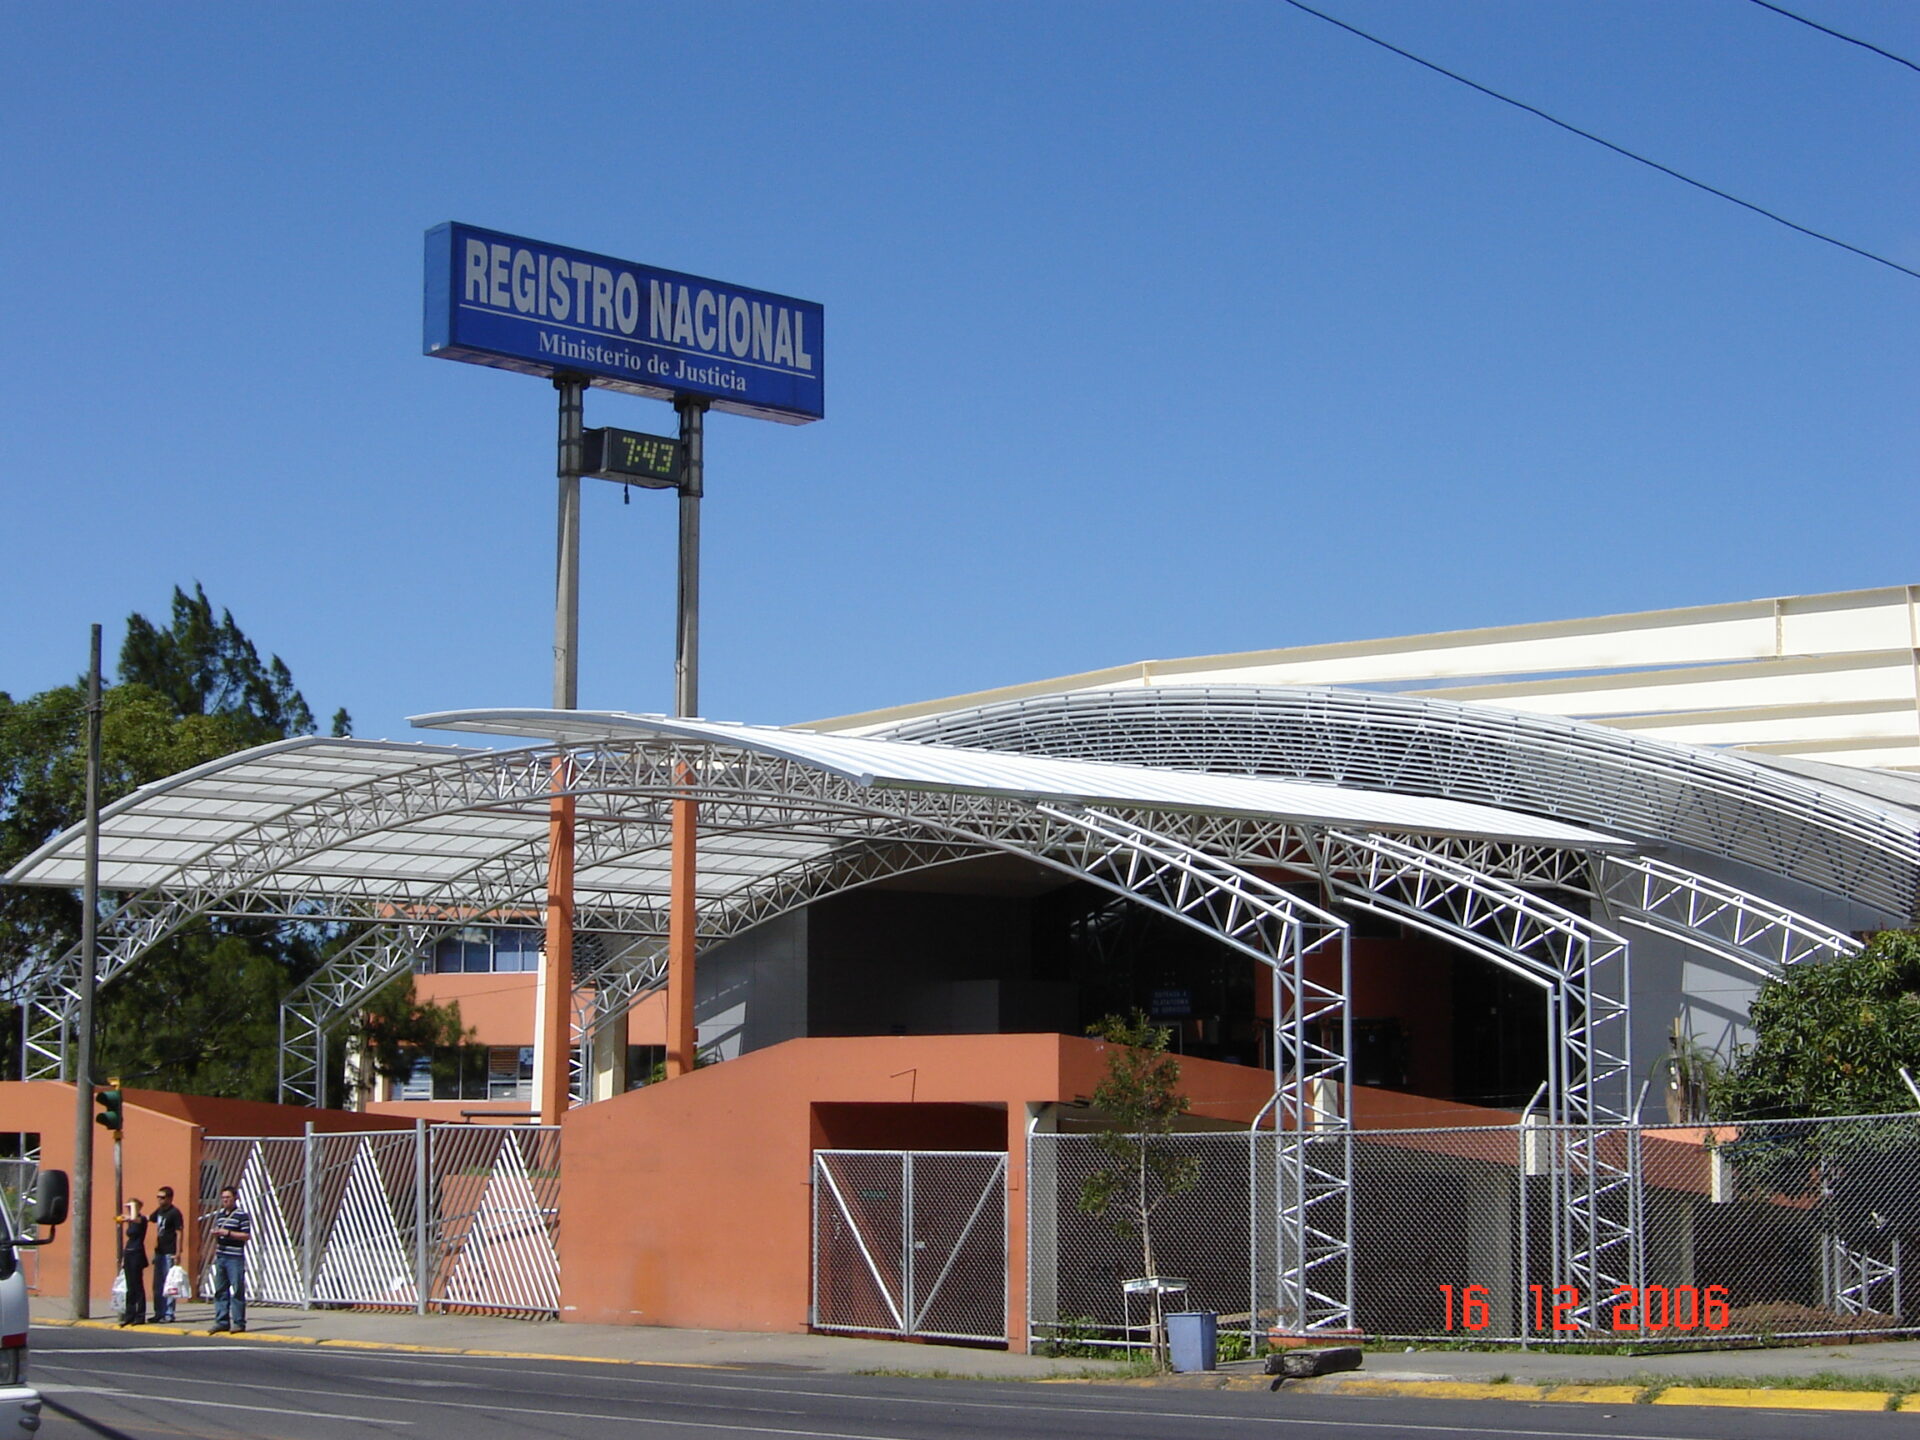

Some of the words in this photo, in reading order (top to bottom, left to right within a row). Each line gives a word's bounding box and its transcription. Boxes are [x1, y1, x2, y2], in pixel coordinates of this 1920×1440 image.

[465, 238, 639, 335] REGISTRO
[650, 279, 812, 371] NACIONAL
[539, 331, 641, 371] Ministerio
[647, 354, 670, 376] de
[674, 359, 746, 392] Justicia
[622, 436, 674, 474] 7:43
